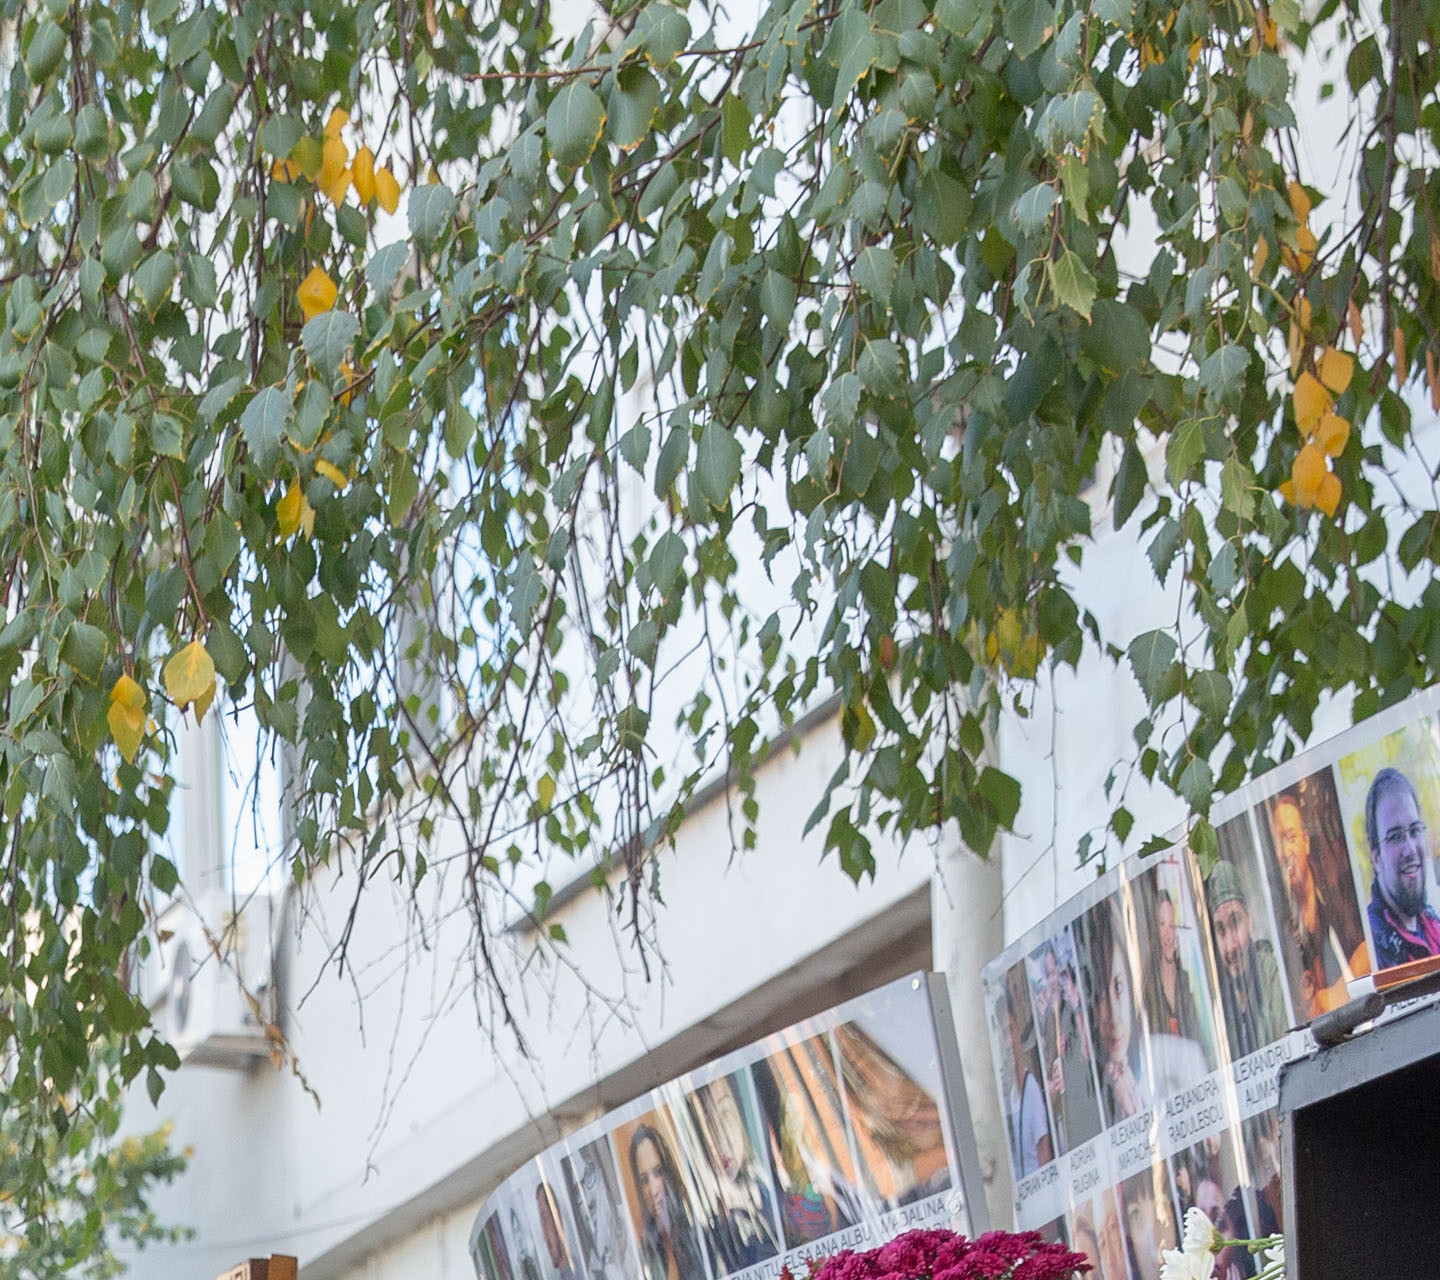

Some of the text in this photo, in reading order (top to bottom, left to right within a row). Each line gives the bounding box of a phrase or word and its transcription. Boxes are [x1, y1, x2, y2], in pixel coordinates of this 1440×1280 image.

[1227, 1040, 1292, 1085] LEXANDRU
[1165, 1077, 1220, 1118] ALEXANDRA
[1167, 1101, 1224, 1144] RADULESCU
[841, 1224, 872, 1248] ALBU
